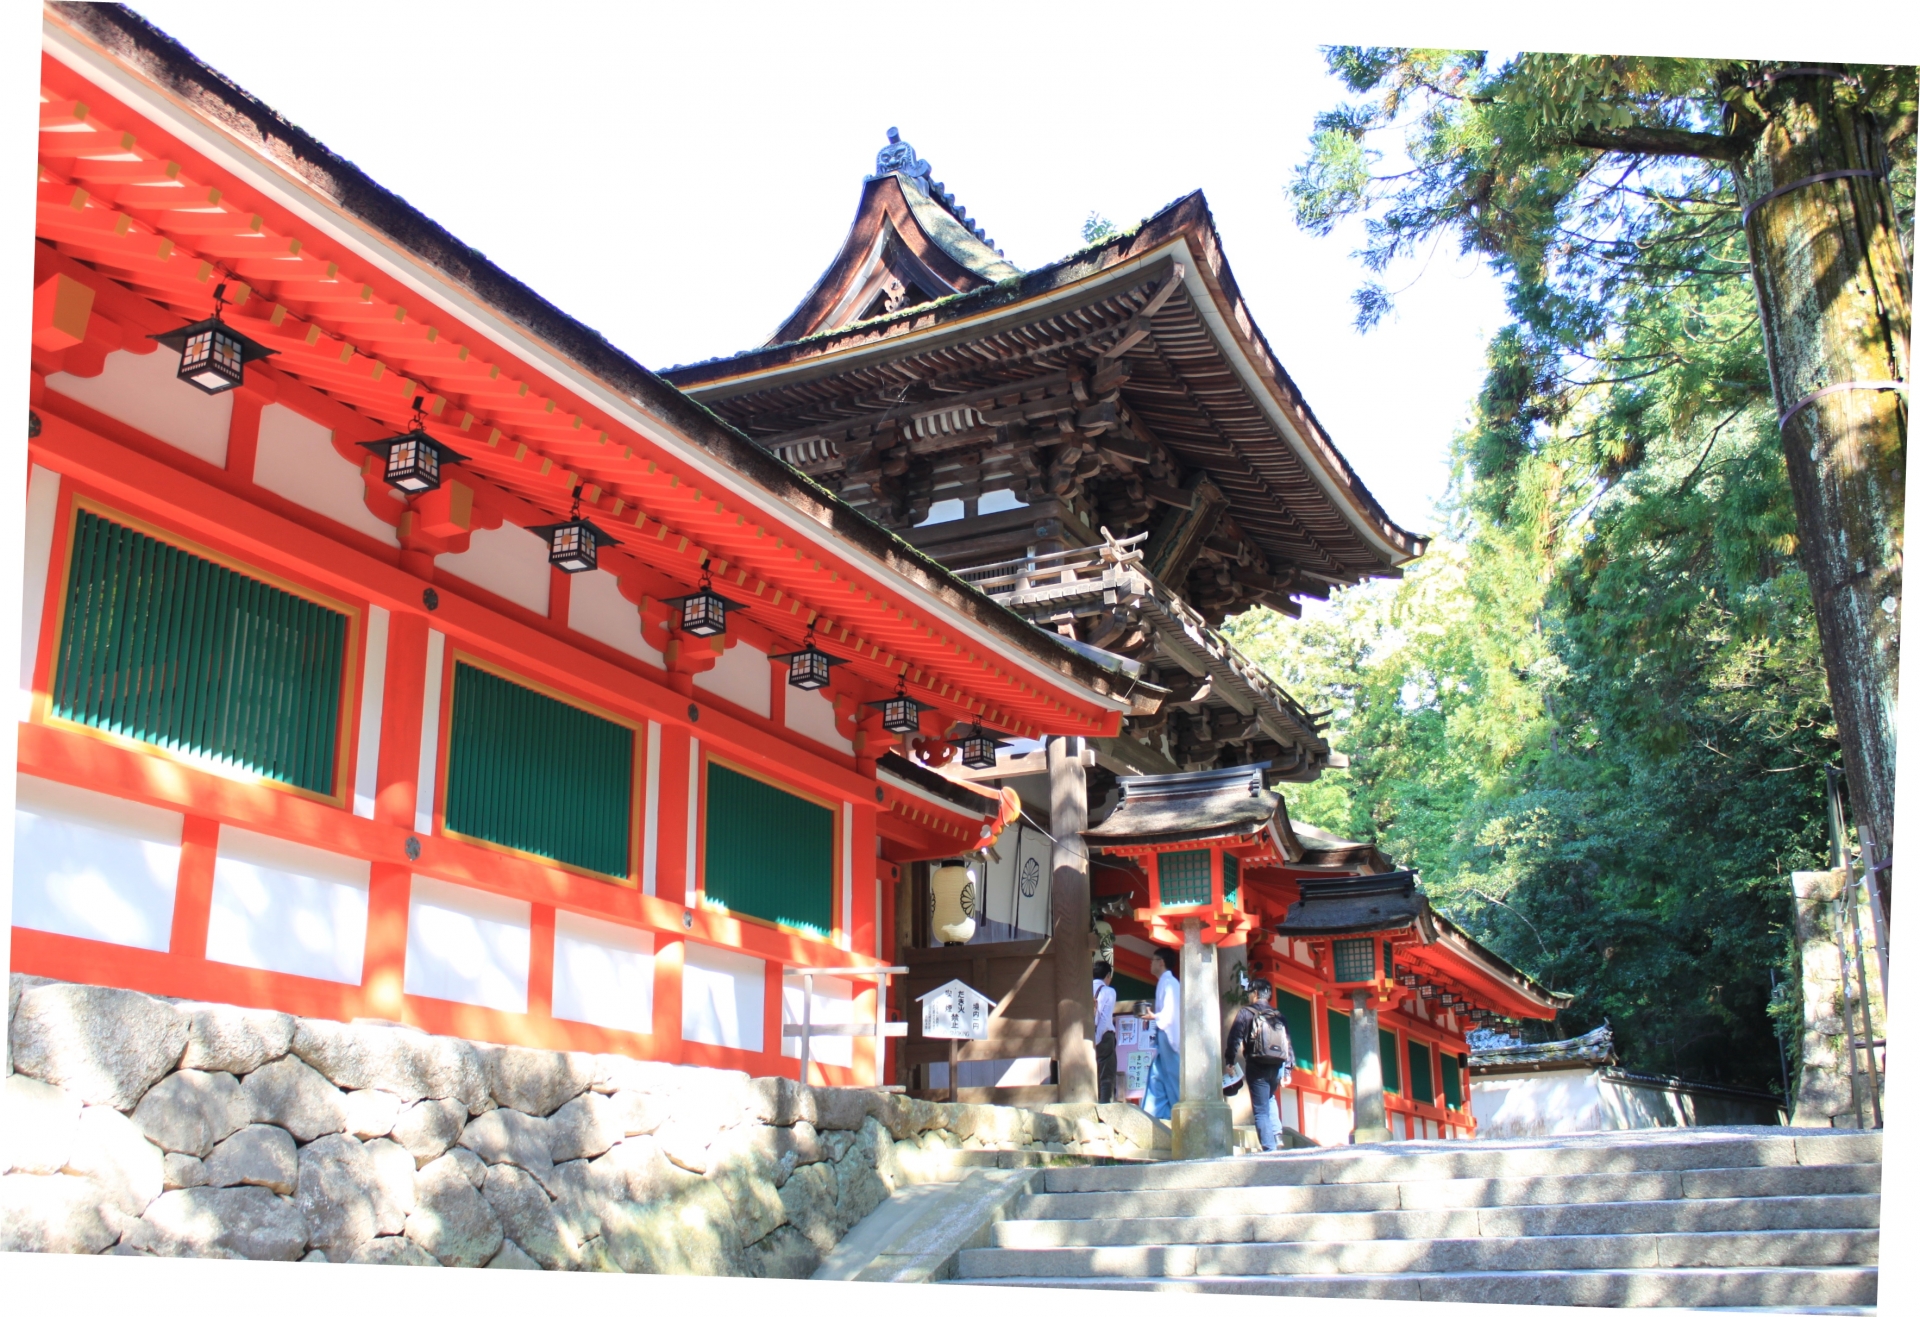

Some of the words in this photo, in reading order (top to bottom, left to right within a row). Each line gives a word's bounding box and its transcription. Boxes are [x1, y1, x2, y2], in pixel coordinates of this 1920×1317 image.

[945, 989, 953, 1013] 喫煙
[950, 1013, 959, 1029] 禁止
[972, 1002, 980, 1030] 境内一円
